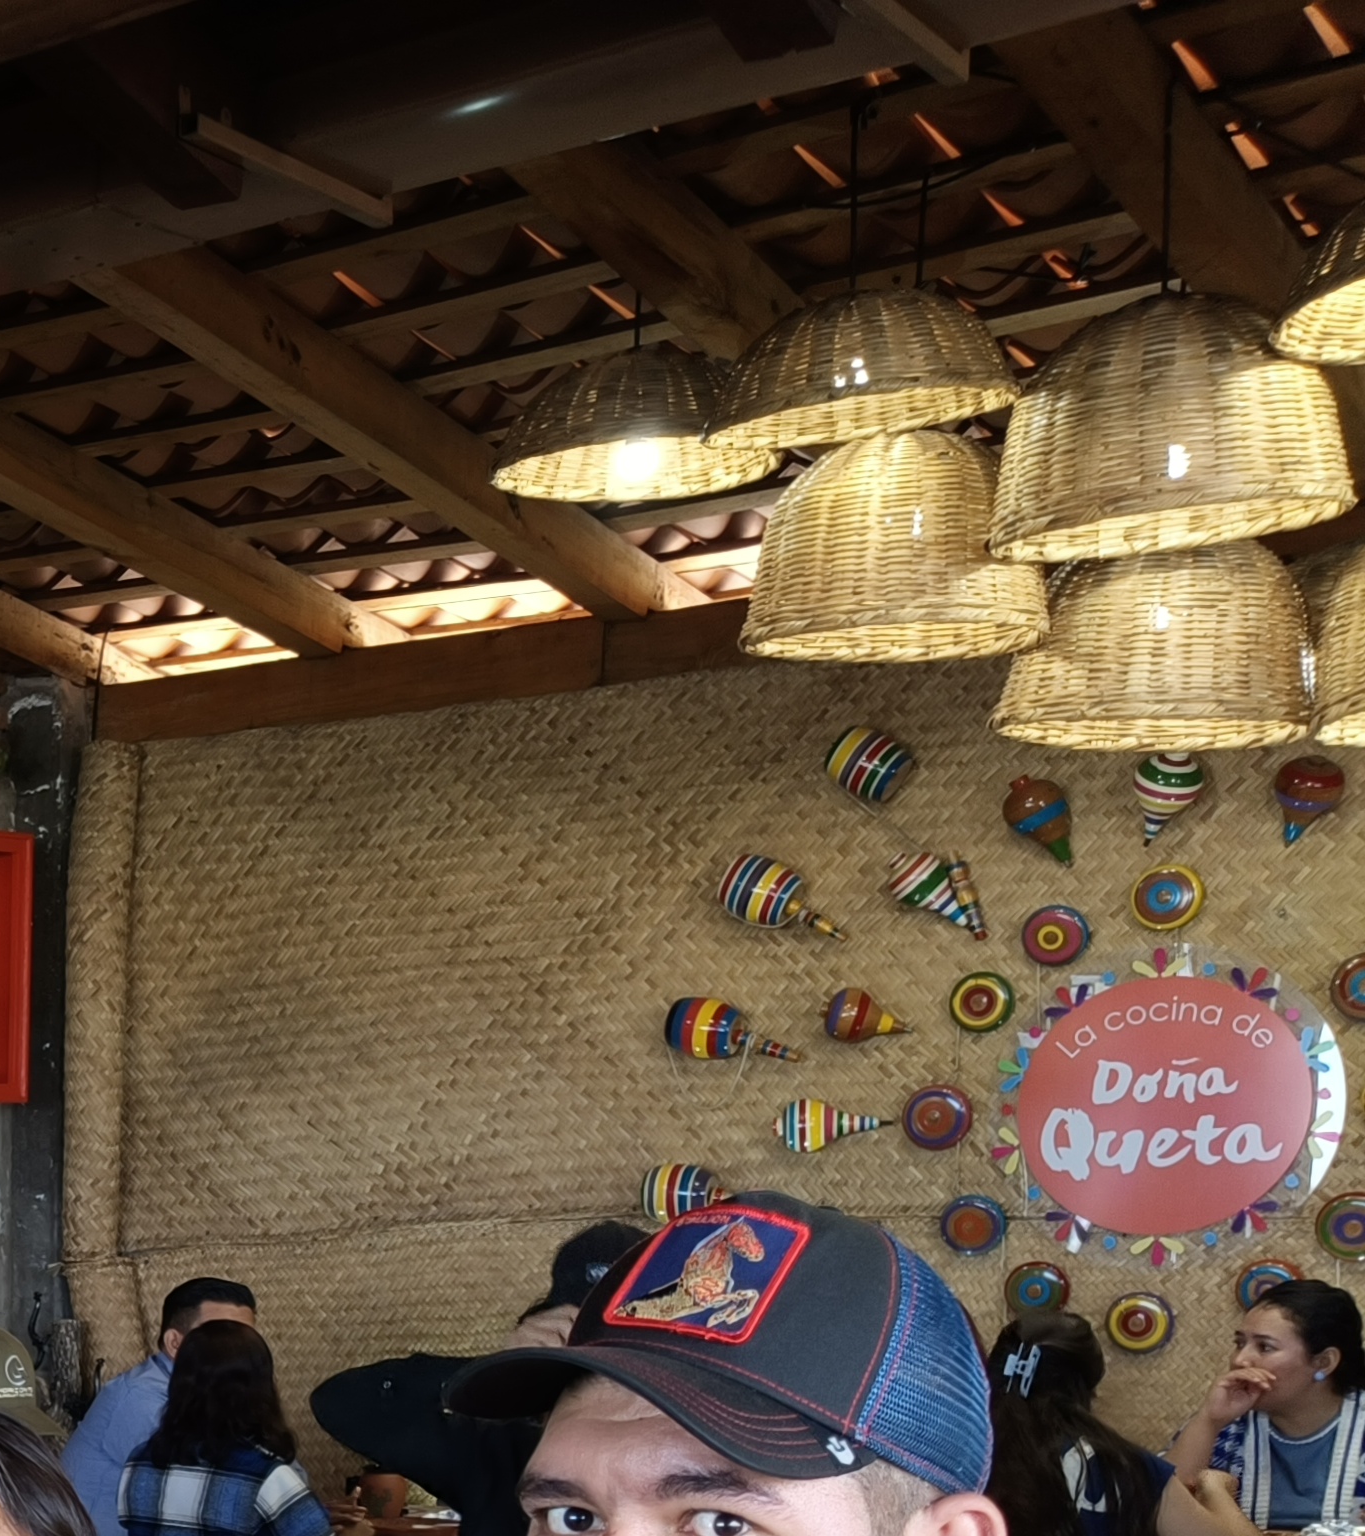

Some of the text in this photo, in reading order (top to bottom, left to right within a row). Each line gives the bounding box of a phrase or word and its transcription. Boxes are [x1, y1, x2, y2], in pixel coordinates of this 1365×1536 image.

[1055, 995, 1274, 1059] La cocina de
[1091, 1056, 1239, 1106] Doña
[1040, 1107, 1283, 1182] Queta
